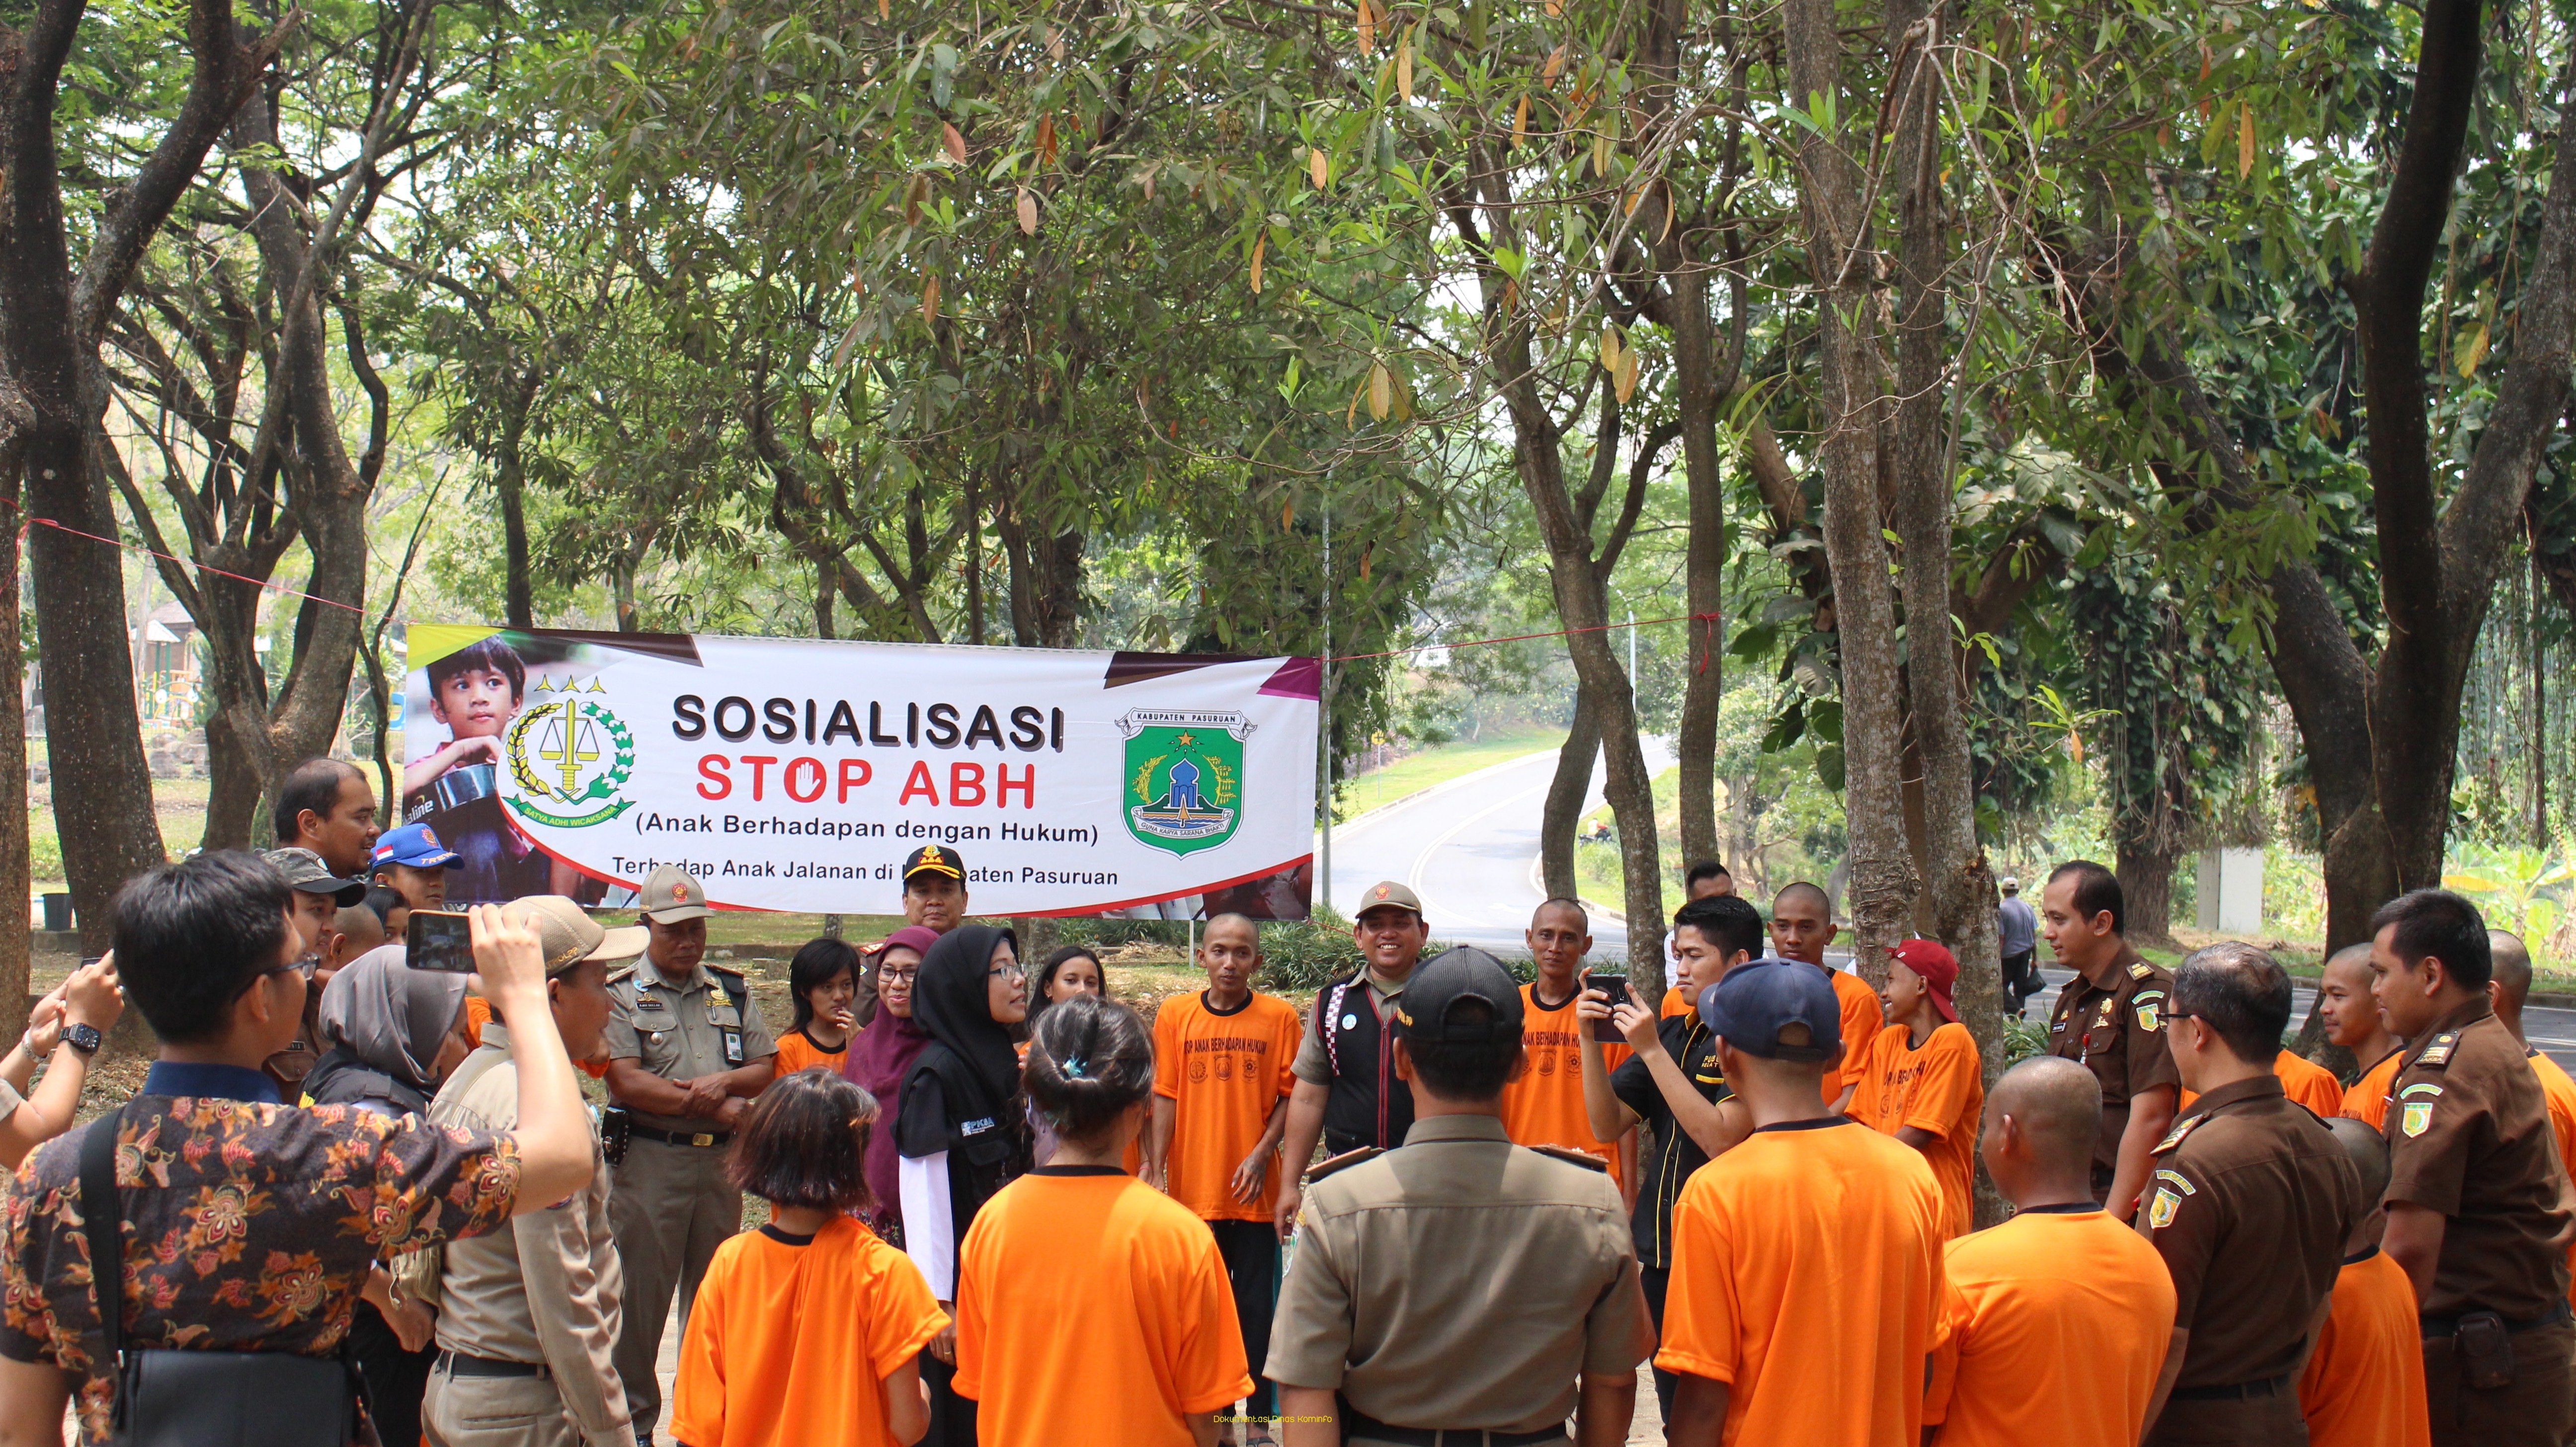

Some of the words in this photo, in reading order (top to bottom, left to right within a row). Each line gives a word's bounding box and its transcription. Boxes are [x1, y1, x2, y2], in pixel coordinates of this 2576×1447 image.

[672, 694, 1064, 753] SOSIALISASI
[1137, 713, 1185, 722] KABUPATEN
[697, 754, 872, 804] STOP
[899, 760, 1035, 809] ABH
[524, 807, 548, 823] SATYA
[570, 806, 617, 826] WICAKSANA
[637, 812, 713, 835] (Anak
[724, 815, 885, 841] Berhadapan
[895, 819, 990, 844] dengan
[1002, 822, 1097, 847] Hukum)
[1141, 822, 1158, 832] GUNA
[1205, 823, 1225, 834] BHAKTI
[612, 857, 714, 879] Terhdap
[723, 860, 775, 878] Anak
[783, 861, 866, 879] Jalanan
[875, 864, 892, 880] di
[1022, 867, 1117, 885] Pasuruan
[1195, 1038, 1209, 1054] ANAK
[1211, 1037, 1246, 1052] BERHADAPAN
[1247, 1040, 1268, 1055] HUKUM
[1522, 1032, 1535, 1046] NAK
